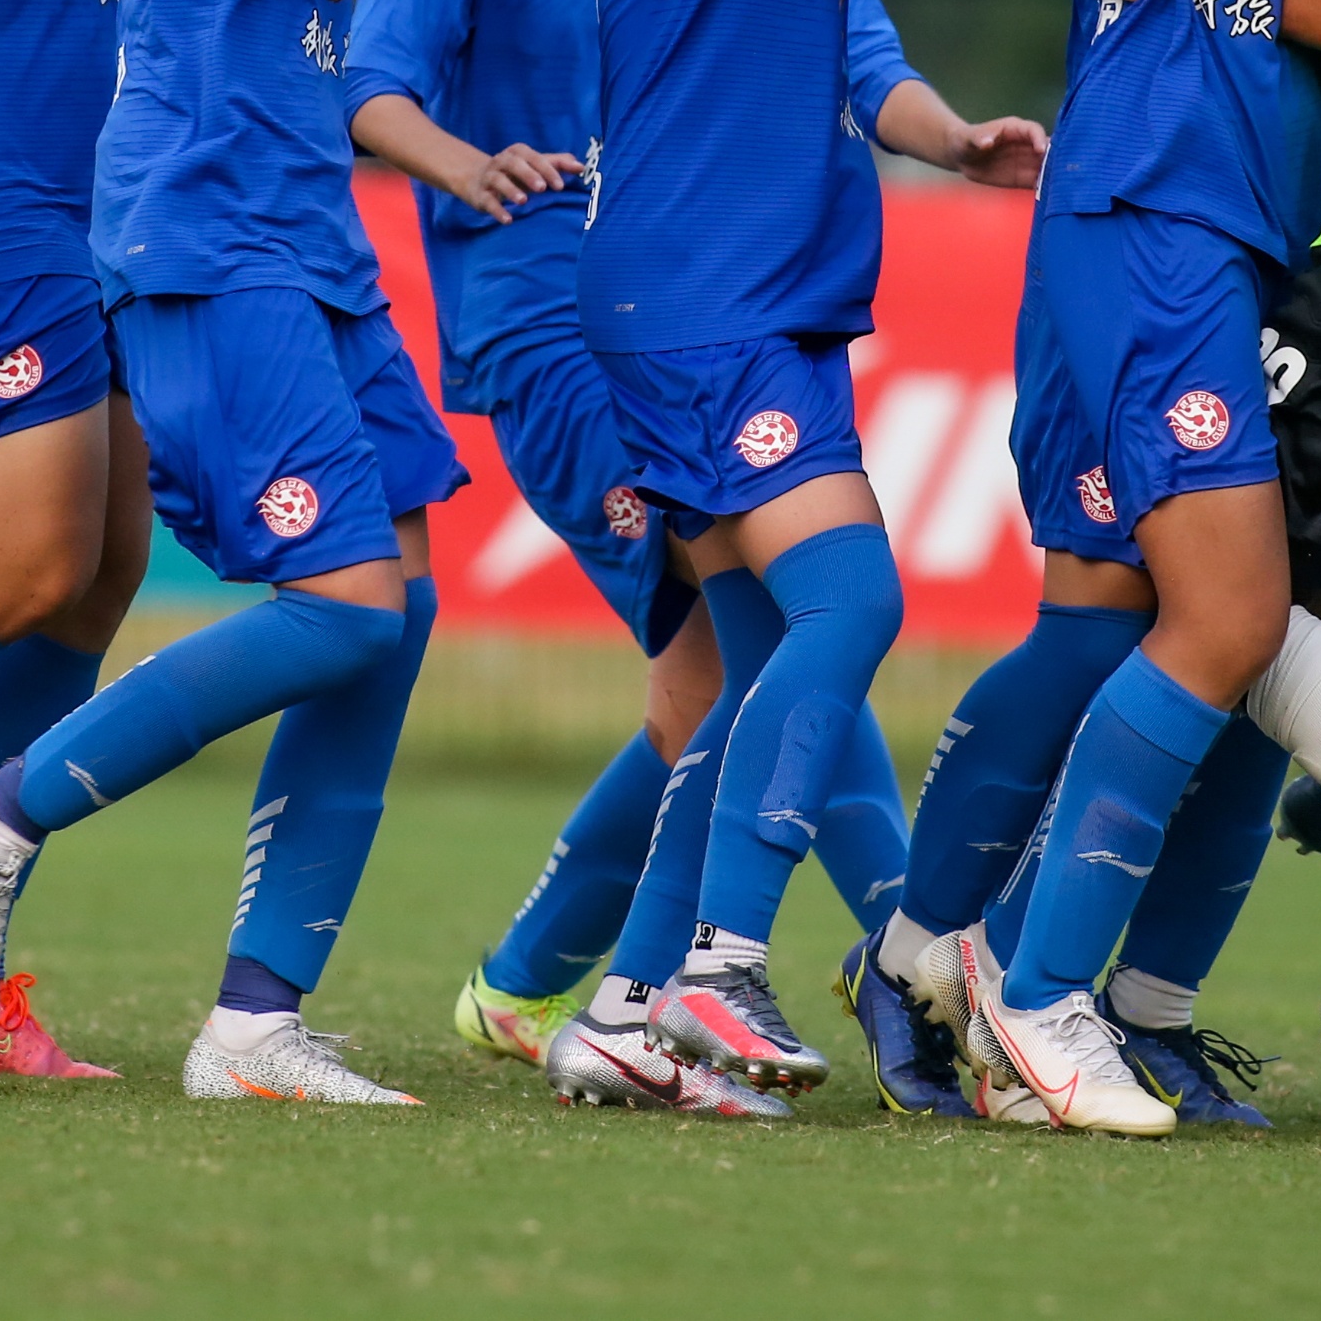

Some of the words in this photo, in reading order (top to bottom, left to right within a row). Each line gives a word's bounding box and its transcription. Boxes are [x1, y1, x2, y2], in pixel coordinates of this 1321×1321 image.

[1177, 427, 1214, 447] FOOTBALL
[748, 451, 785, 466] FOOTBALL
[1084, 494, 1112, 520] FOOTBALL
